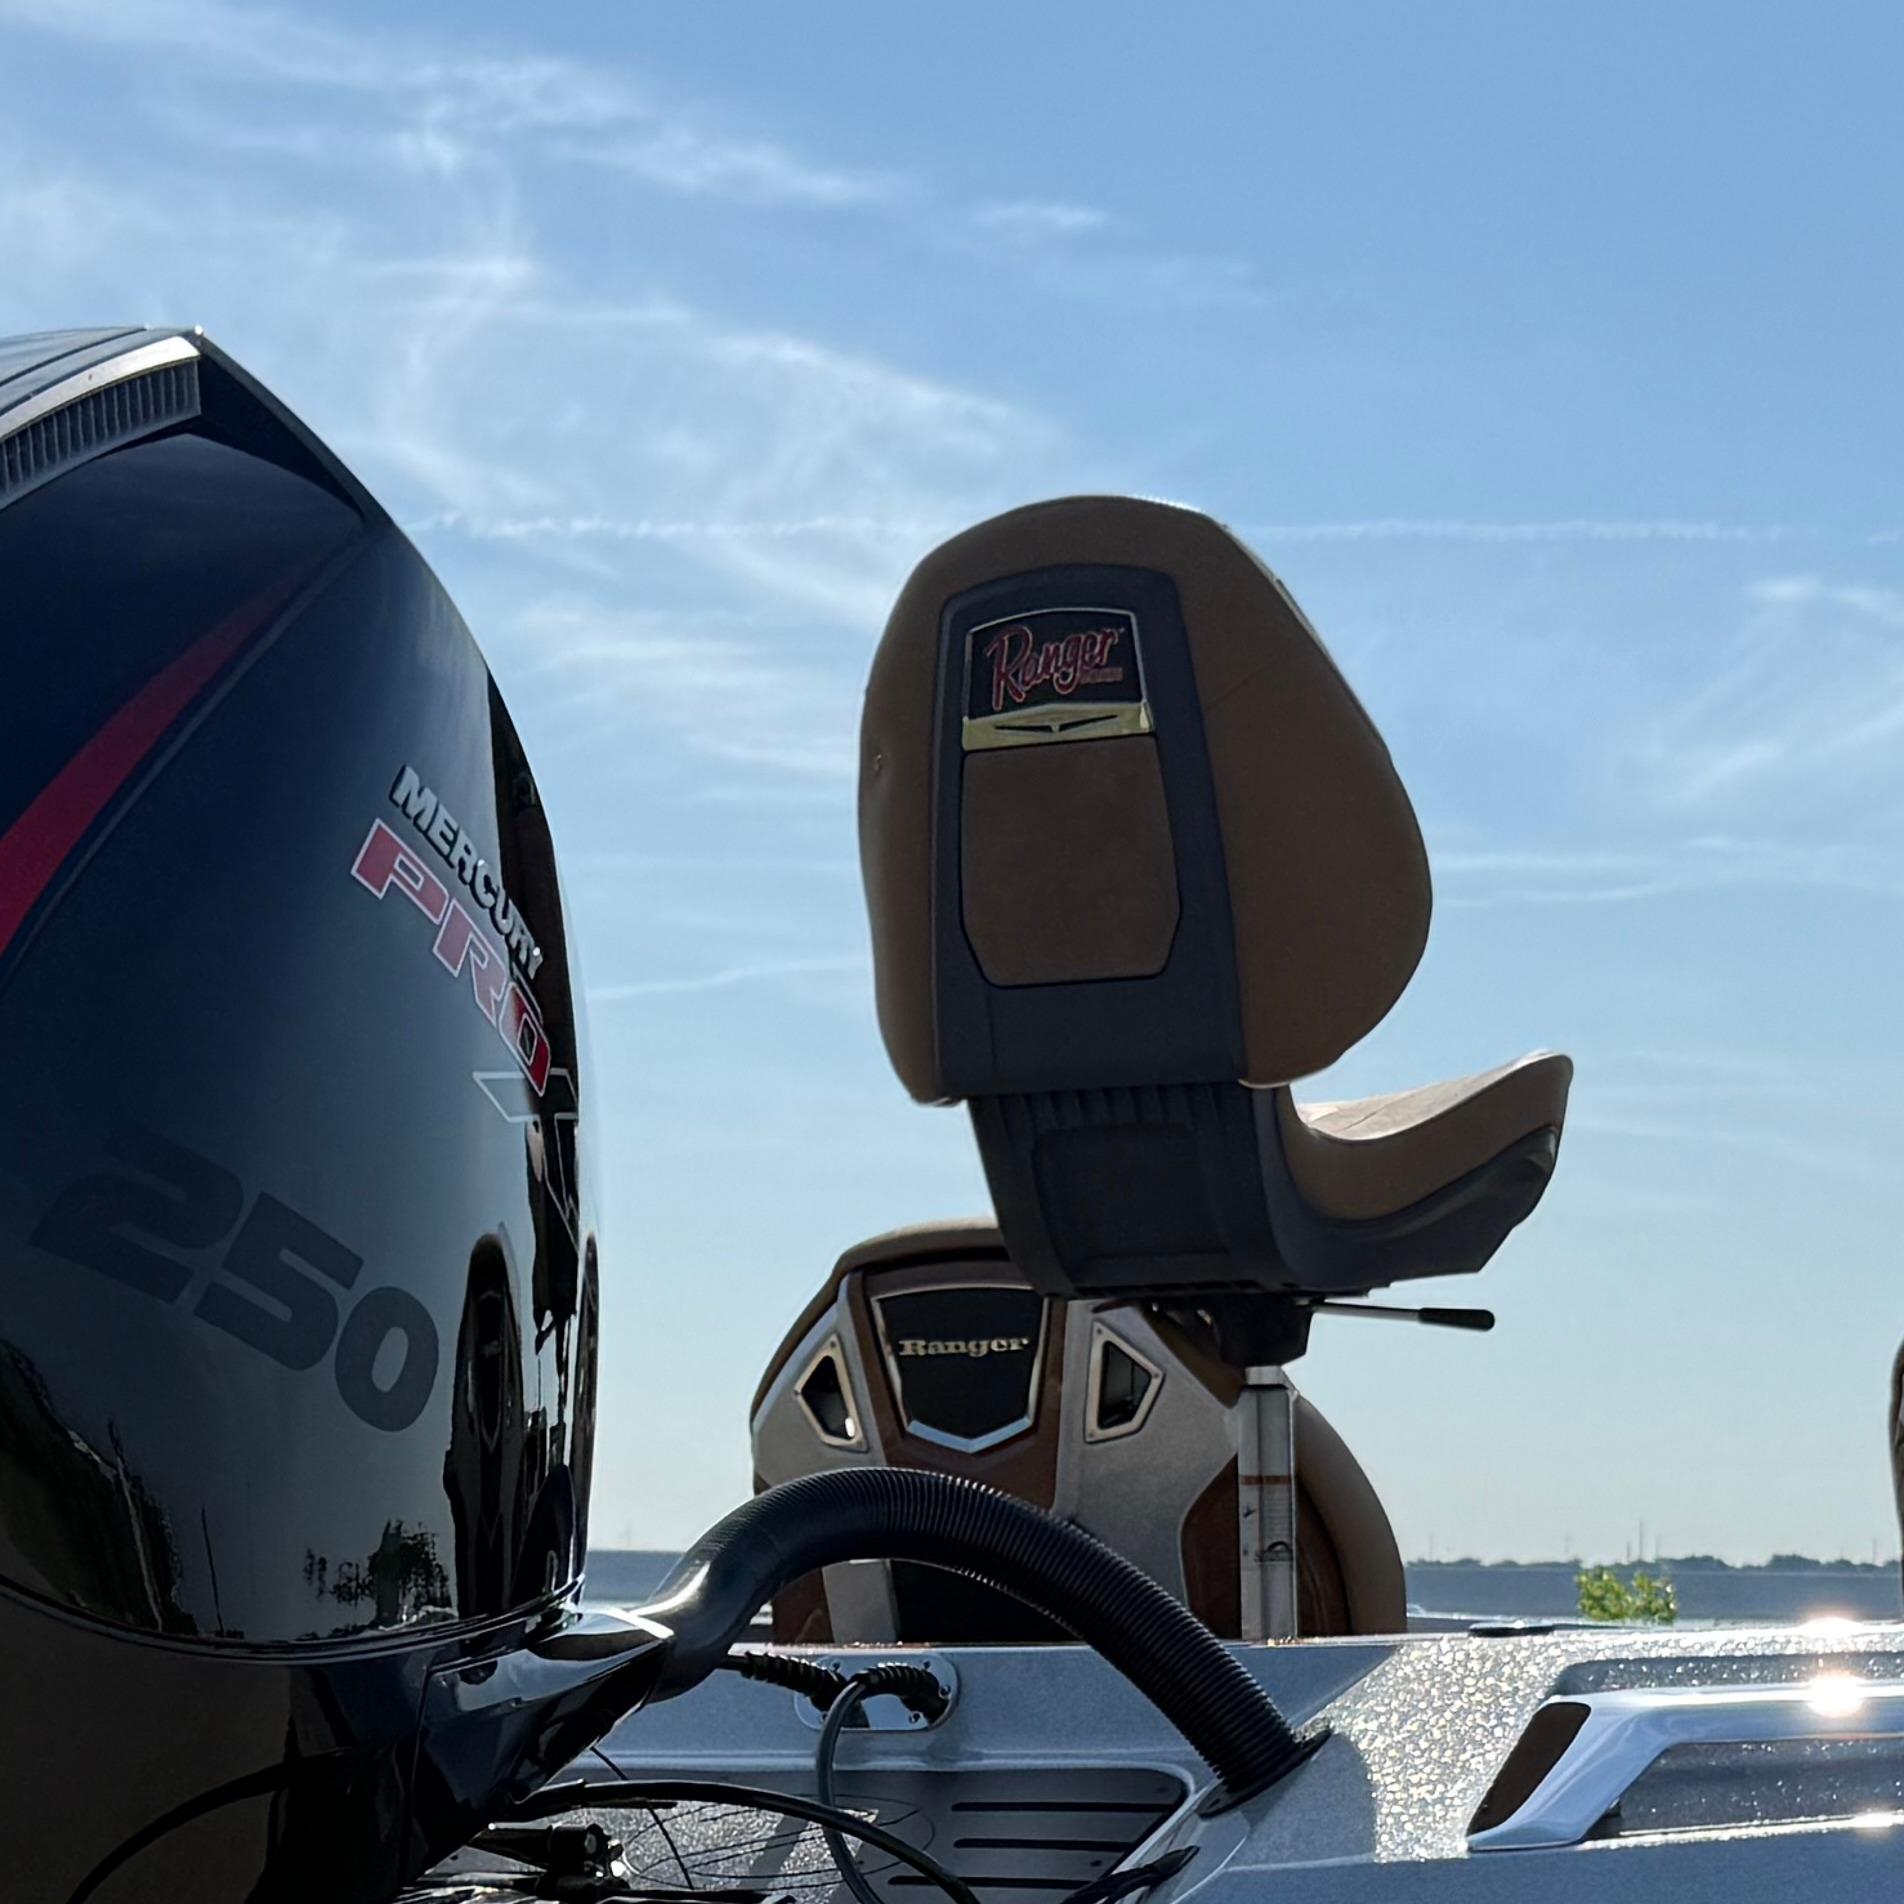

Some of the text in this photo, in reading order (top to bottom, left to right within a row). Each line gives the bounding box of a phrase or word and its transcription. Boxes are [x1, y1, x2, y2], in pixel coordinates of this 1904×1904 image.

[985, 624, 1120, 711] Ranger
[350, 818, 552, 1097] PRO
[389, 765, 544, 980] MERCURY
[28, 1130, 440, 1432] 250
[898, 1333, 1031, 1361] Ranger
